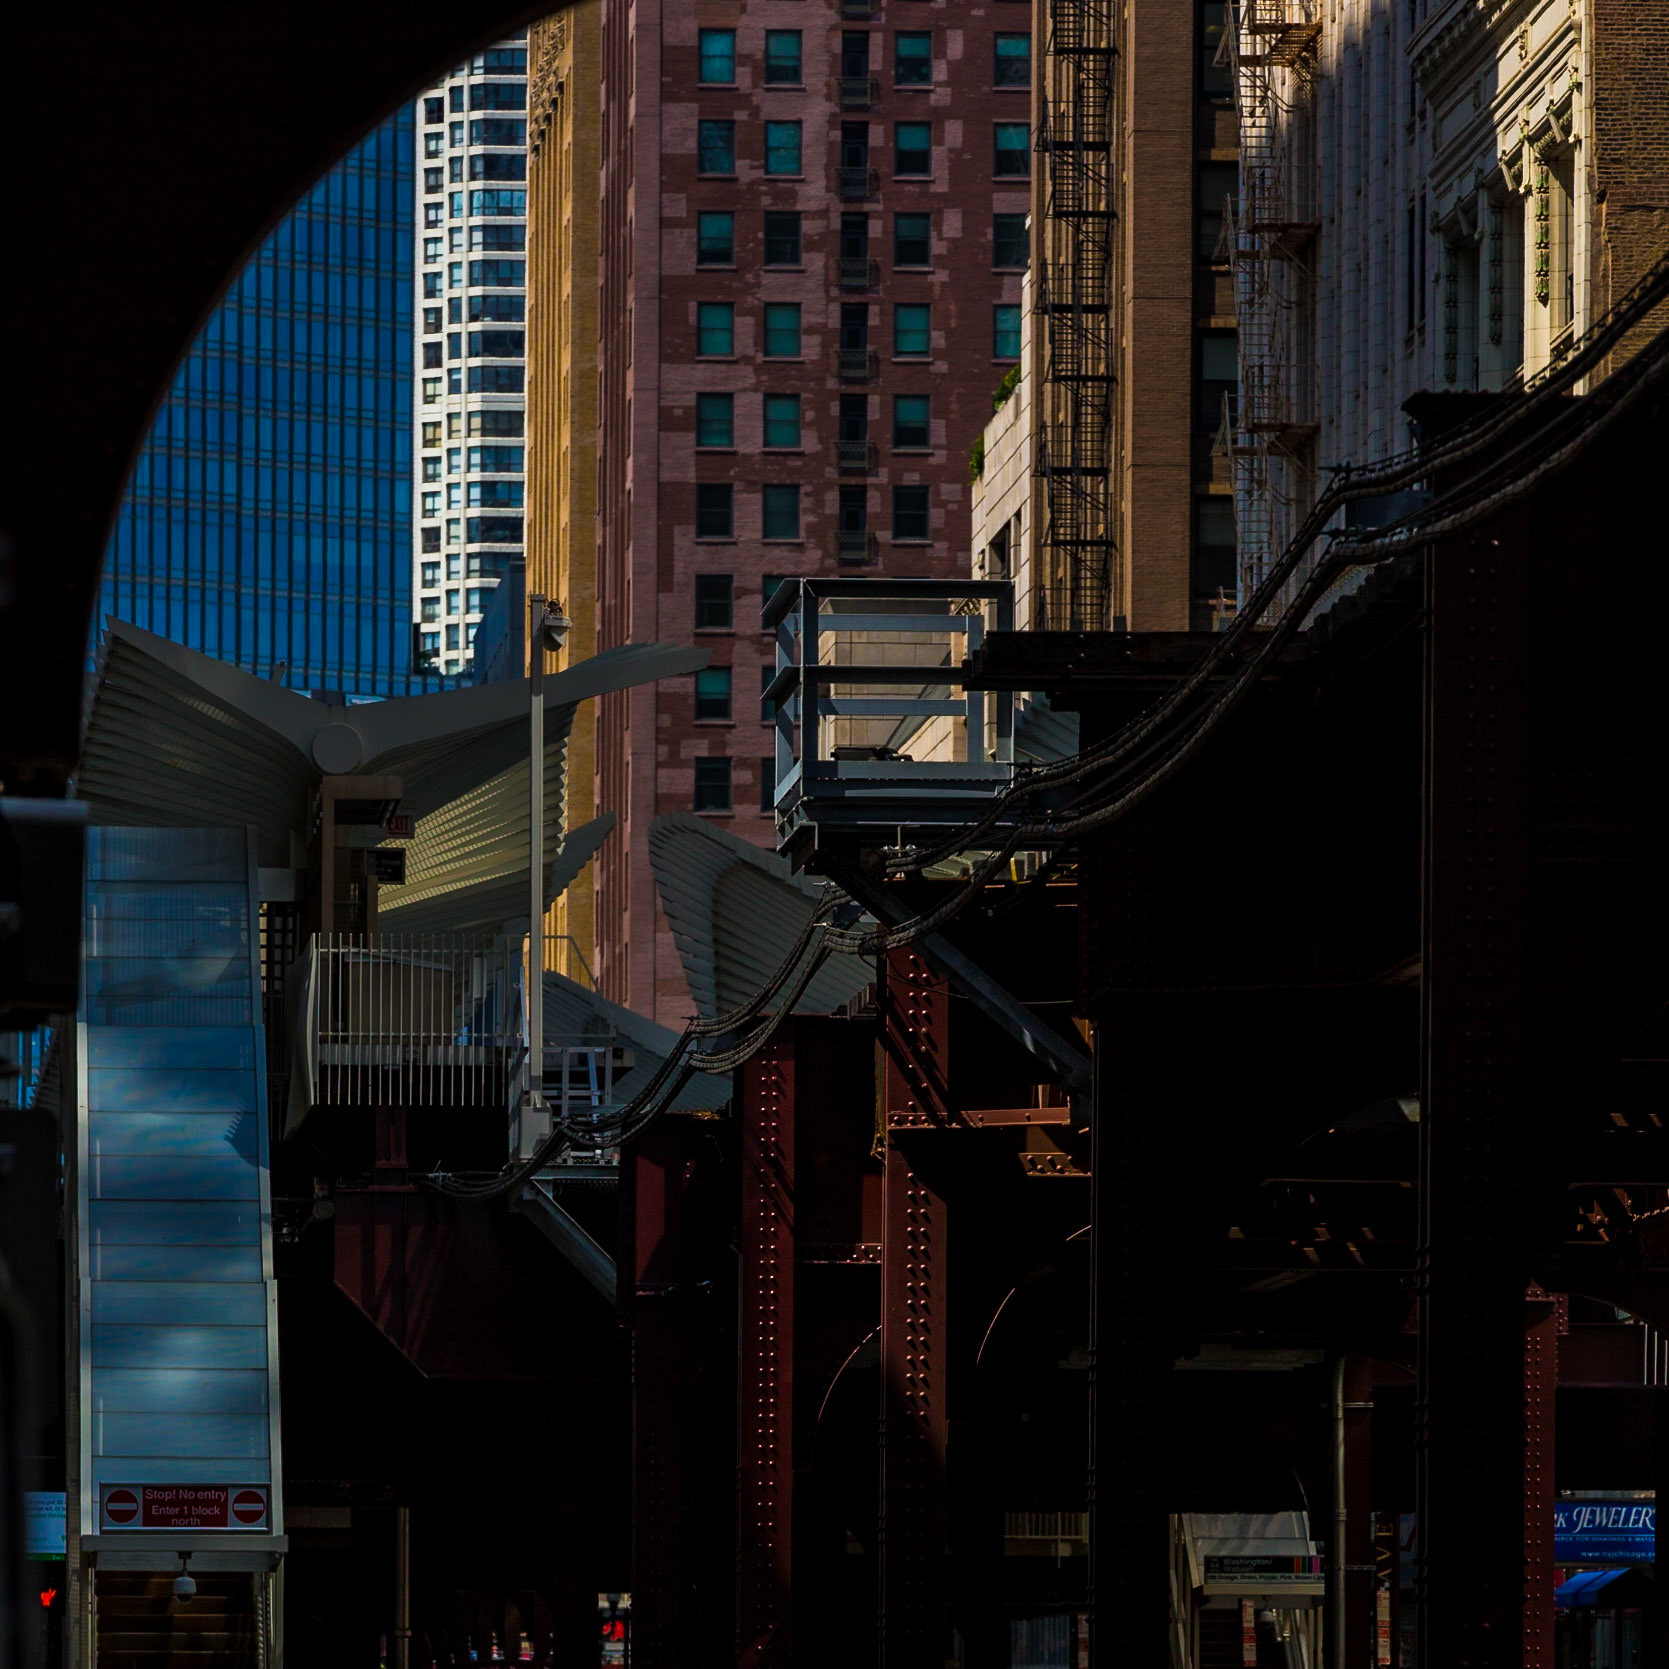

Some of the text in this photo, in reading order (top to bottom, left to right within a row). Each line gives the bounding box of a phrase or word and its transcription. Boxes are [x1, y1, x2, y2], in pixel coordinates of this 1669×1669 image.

[145, 1488, 227, 1502] Stop! No entry
[152, 1505, 221, 1515] Enter 1 block
[171, 1516, 201, 1526] north
[1572, 1506, 1656, 1533] JEWELER
